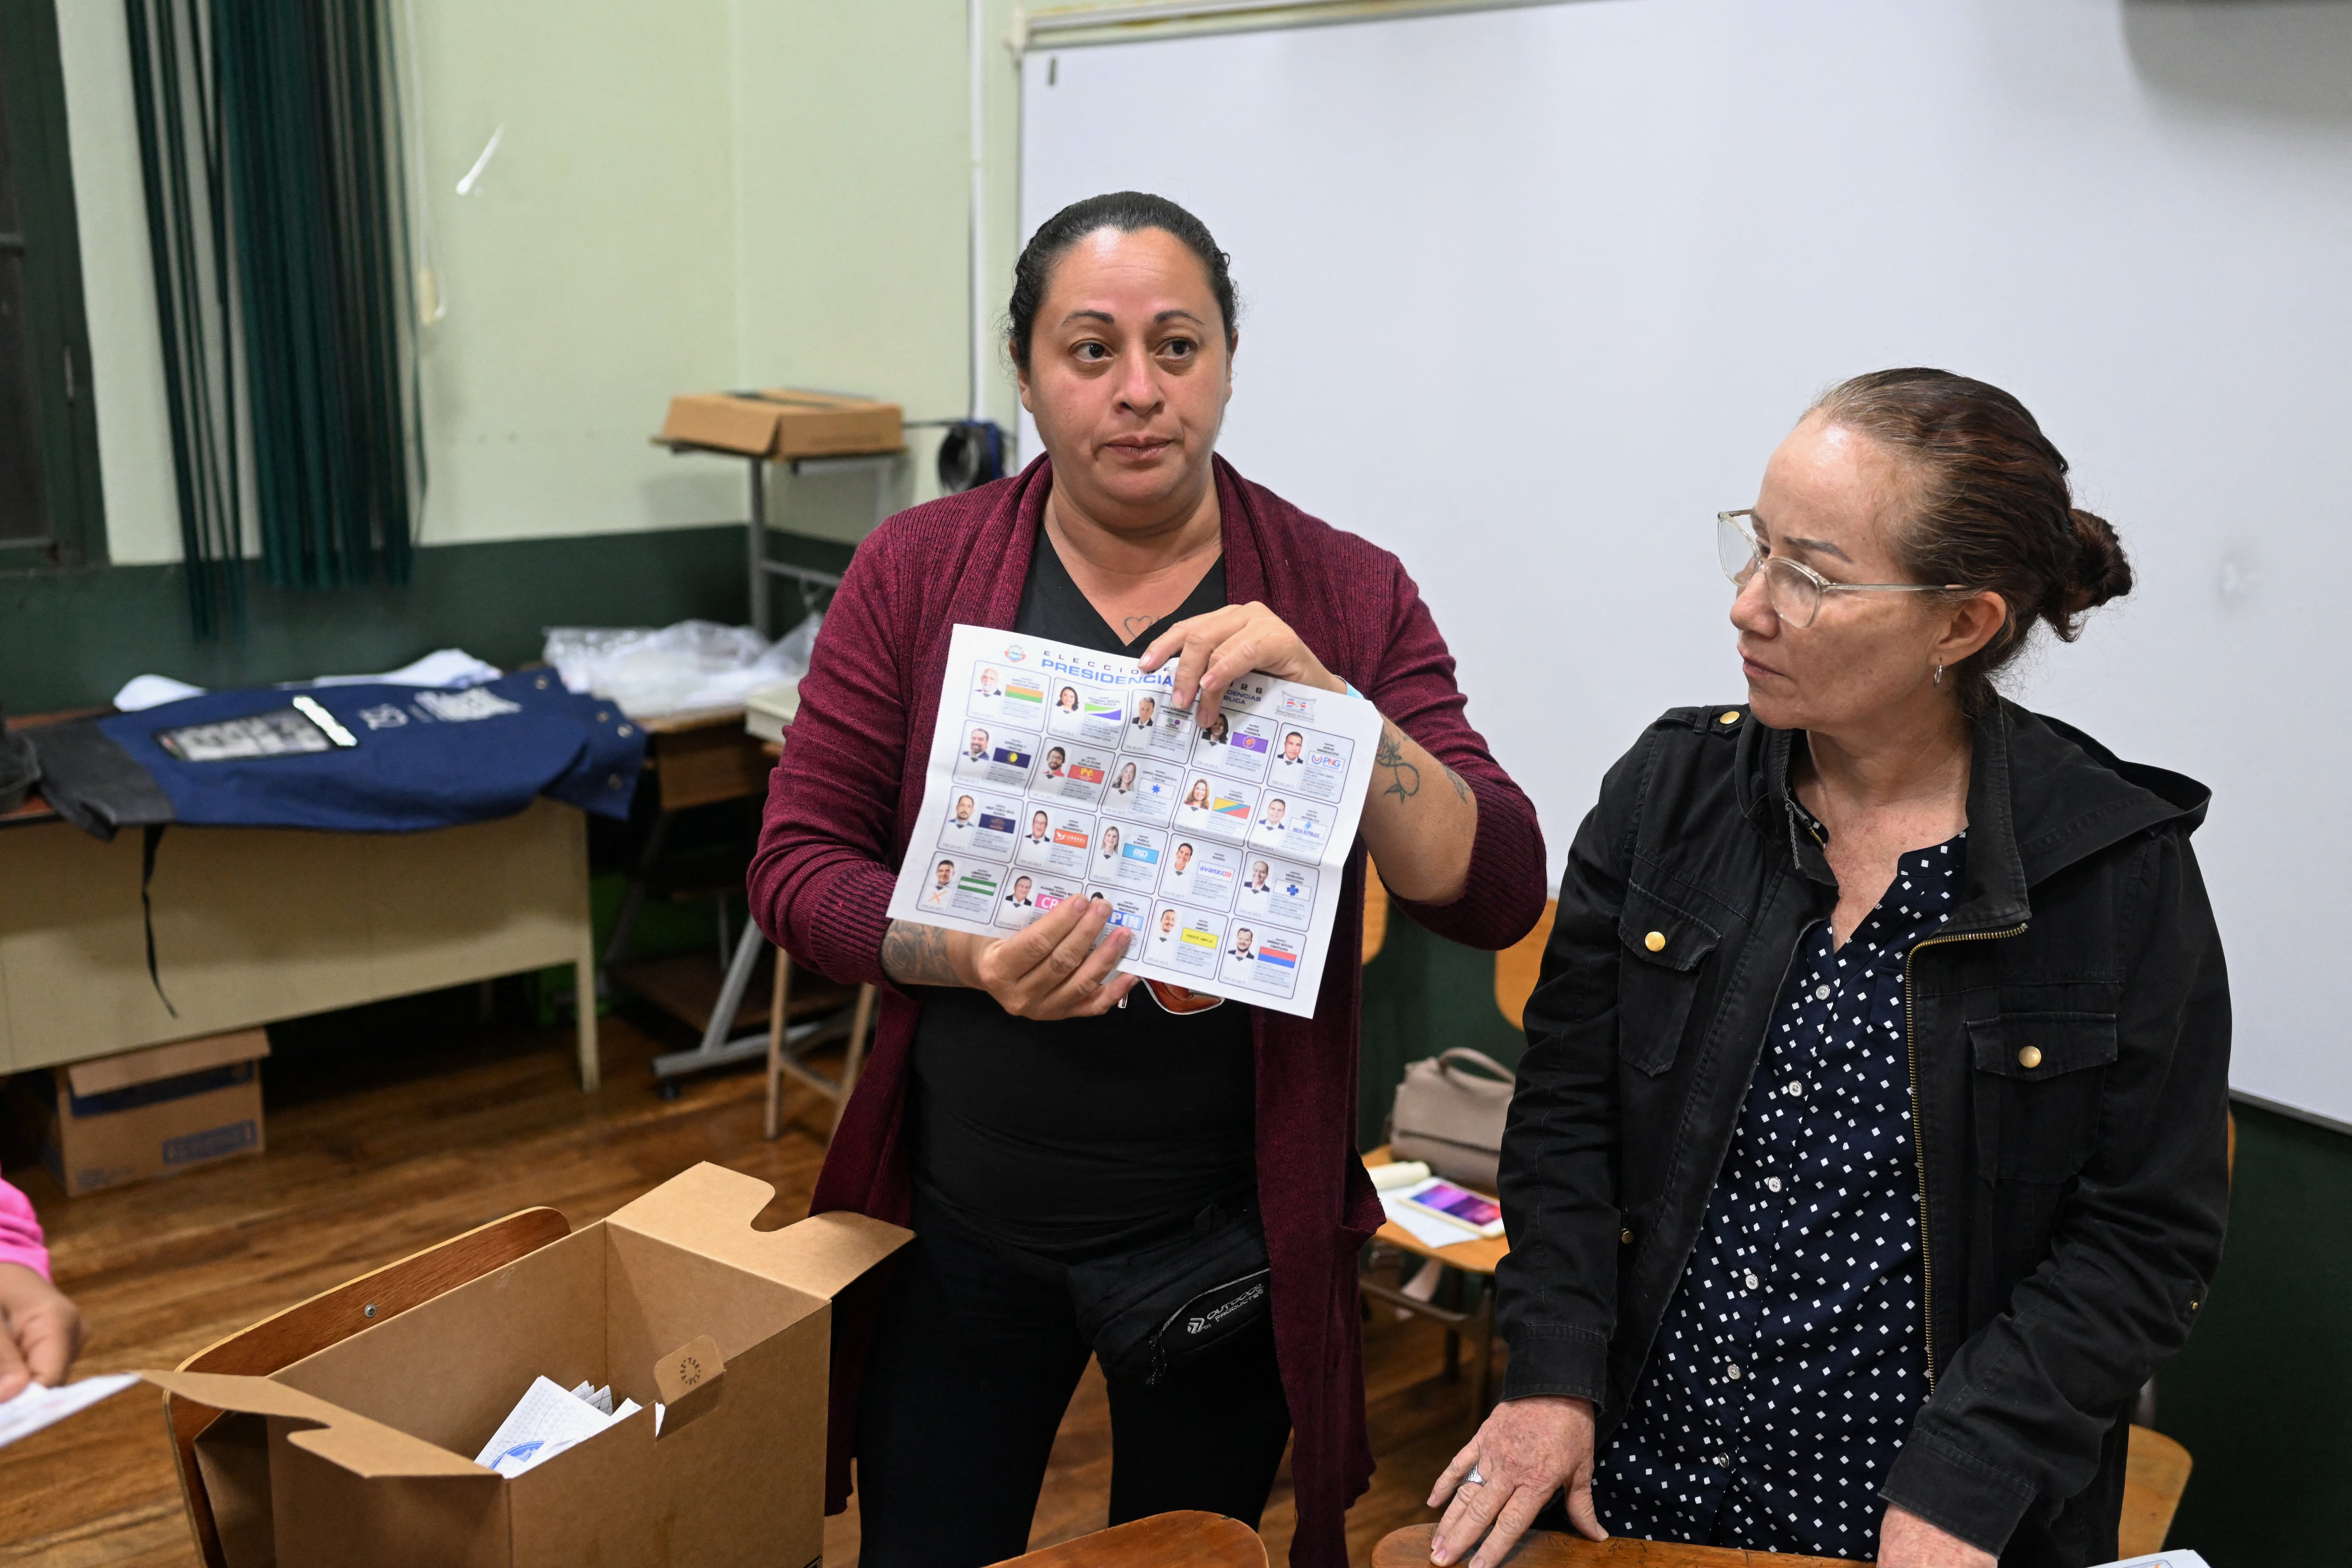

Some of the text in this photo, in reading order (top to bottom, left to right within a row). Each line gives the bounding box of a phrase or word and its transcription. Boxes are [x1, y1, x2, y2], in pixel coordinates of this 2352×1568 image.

[1041, 658, 1174, 687] PRESIDENCIA
[1323, 756, 1341, 768] PNG
[1110, 912, 1140, 929] PIN
[1207, 1284, 1264, 1320] OUTDOOR
